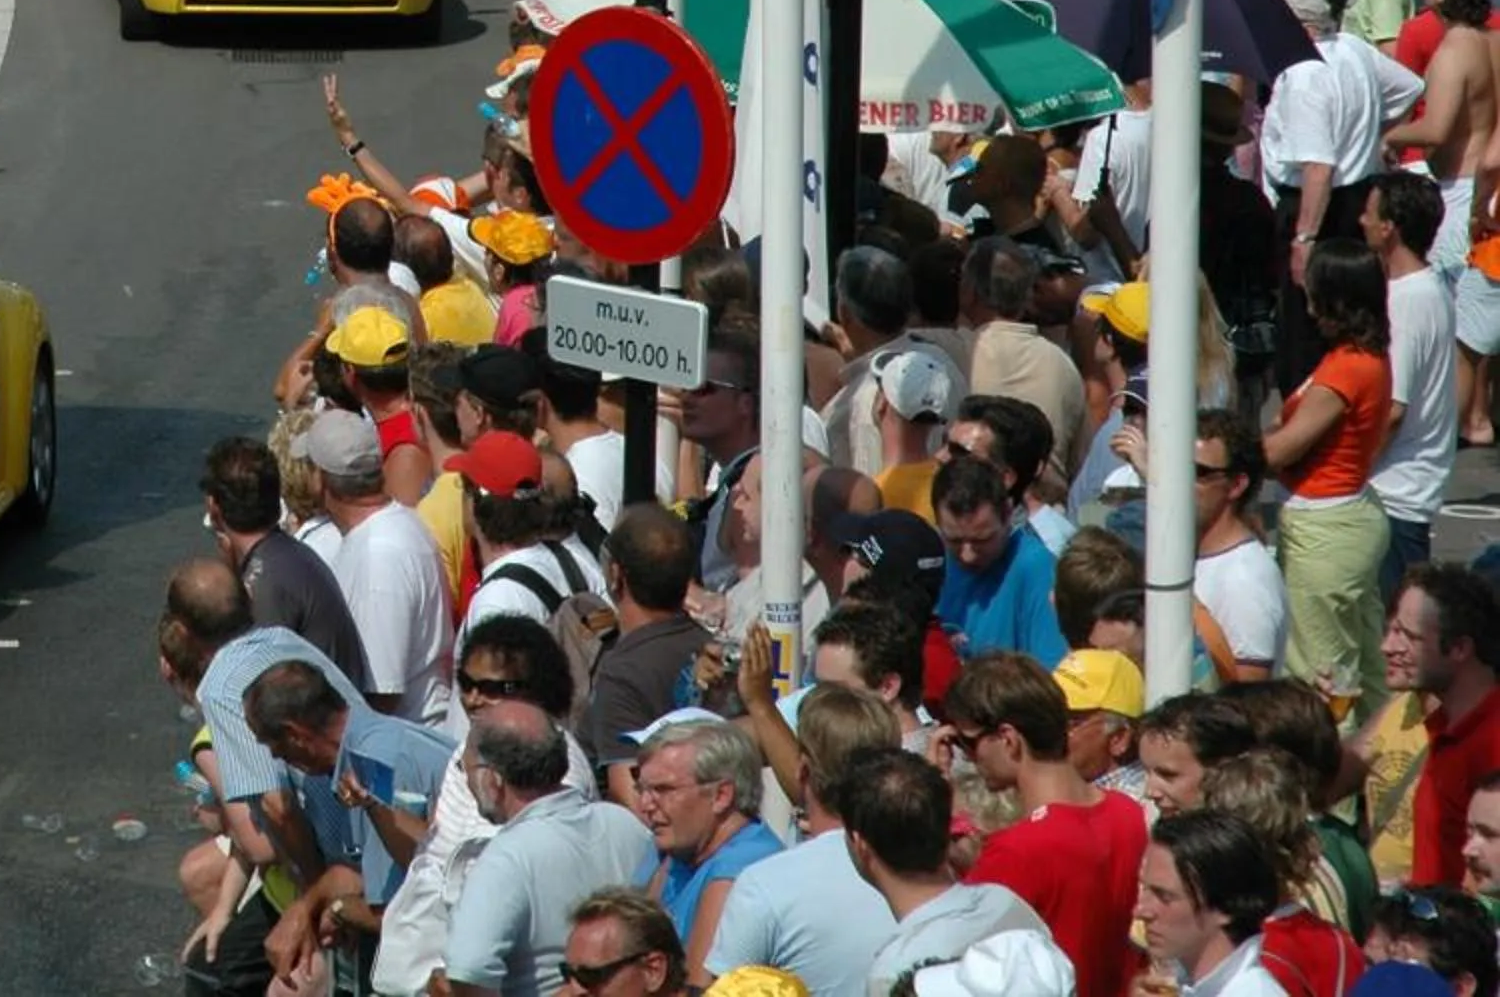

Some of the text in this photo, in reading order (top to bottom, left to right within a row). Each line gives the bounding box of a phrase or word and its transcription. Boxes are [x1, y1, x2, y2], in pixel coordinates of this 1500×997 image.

[859, 101, 987, 124] ENER BIER
[596, 301, 649, 327] m.u.v.
[554, 324, 692, 374] 20.00-10.00 h.
